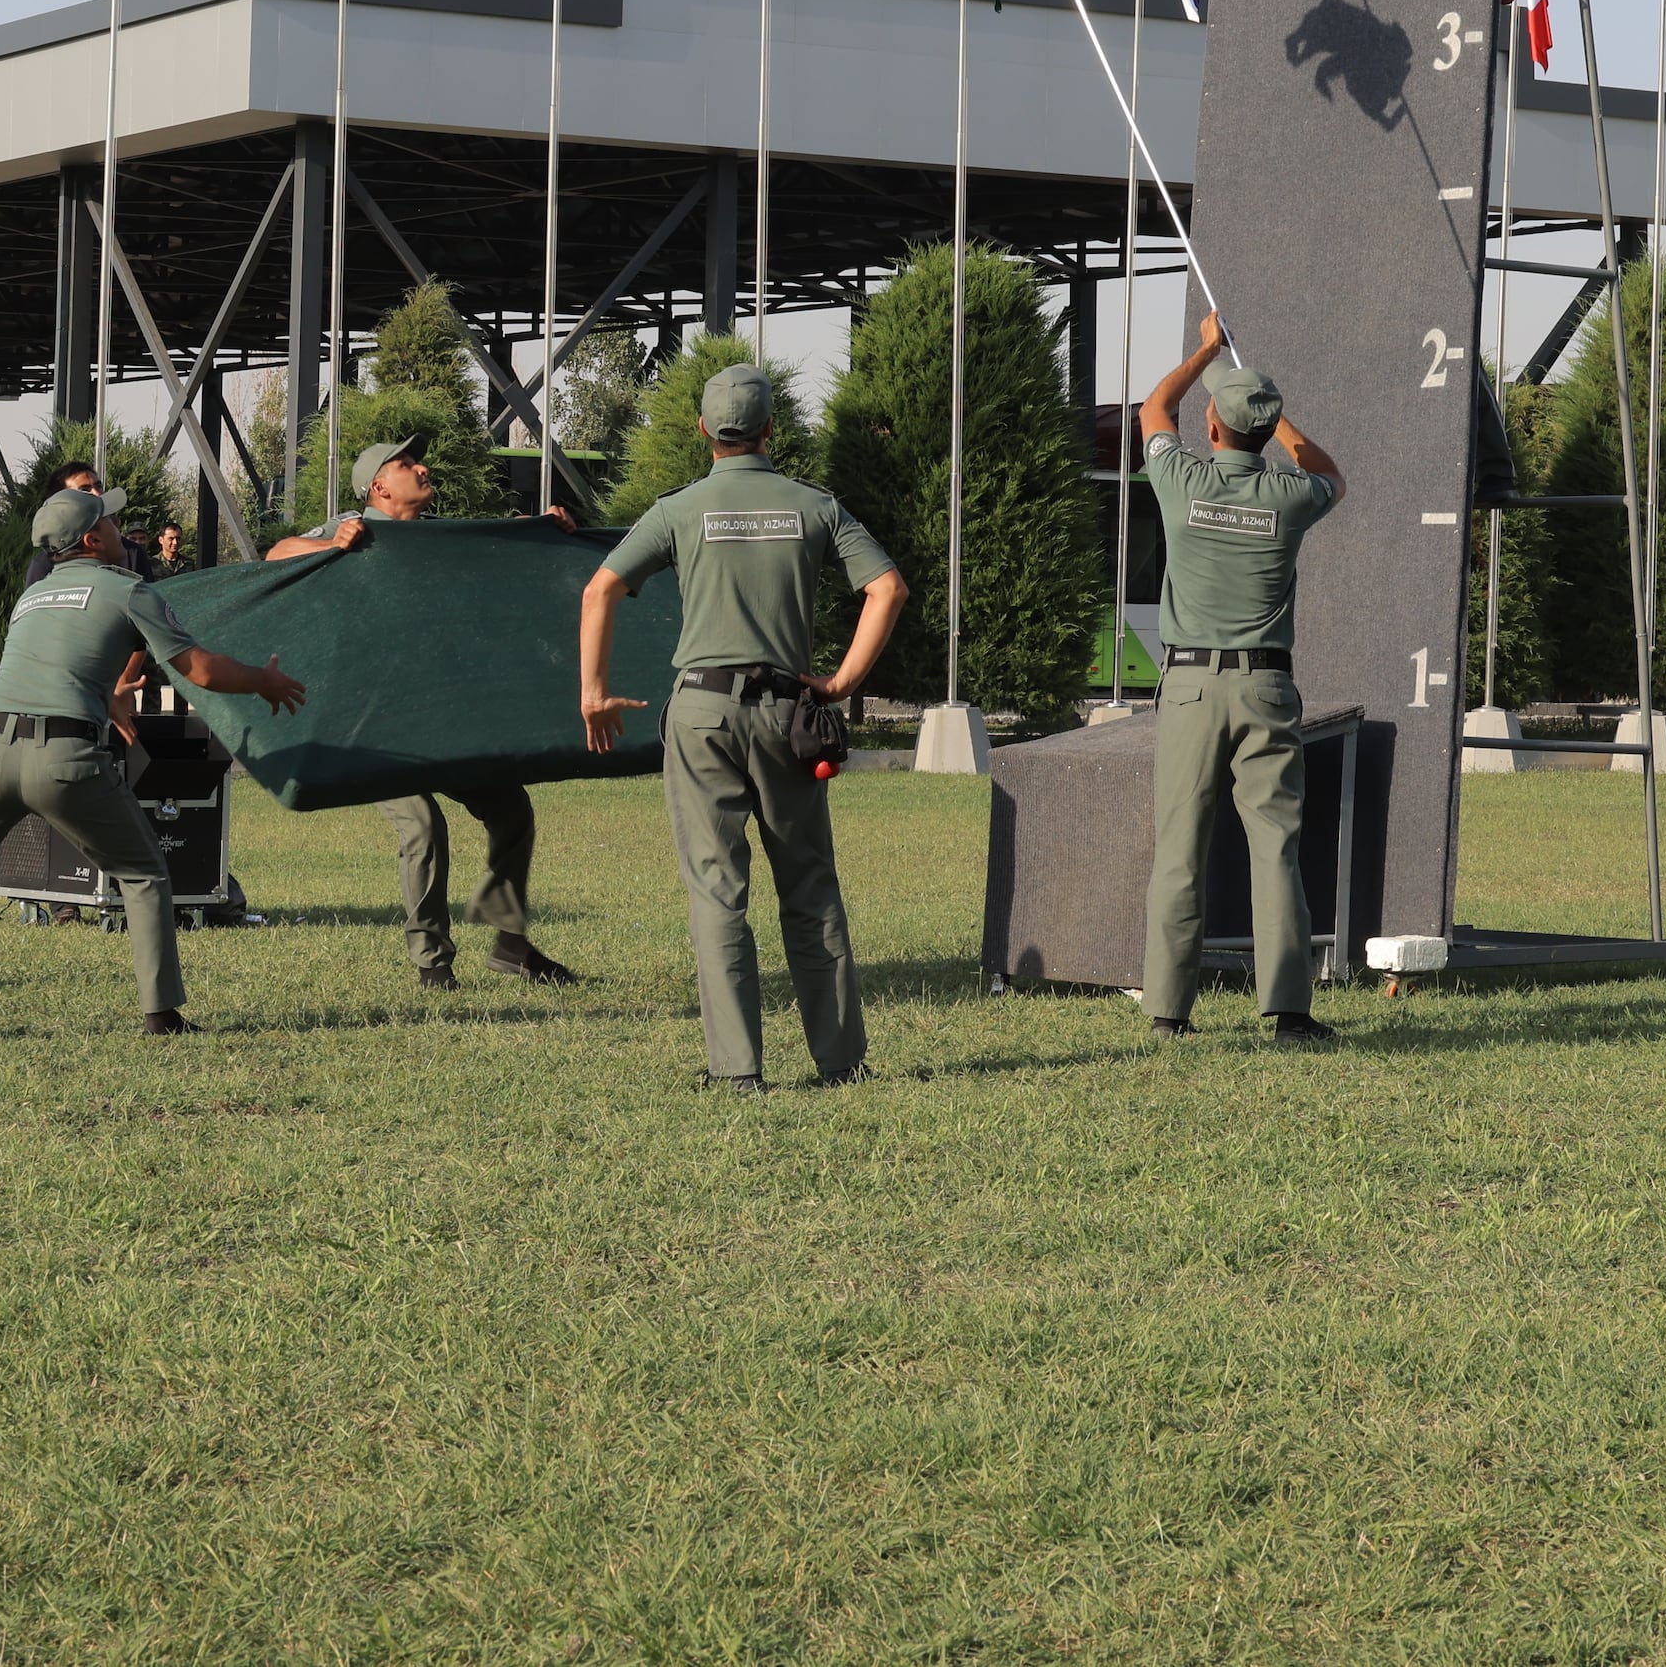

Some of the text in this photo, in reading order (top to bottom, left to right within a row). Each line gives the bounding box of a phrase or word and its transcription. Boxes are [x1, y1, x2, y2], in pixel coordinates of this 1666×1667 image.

[1433, 11, 1461, 71] 3
[1420, 327, 1447, 388] 2
[707, 519, 798, 531] KINOLOGIYA XIZMATI
[1192, 508, 1272, 527] KINOLOGIYA XIZMATI
[1407, 647, 1430, 707] 1
